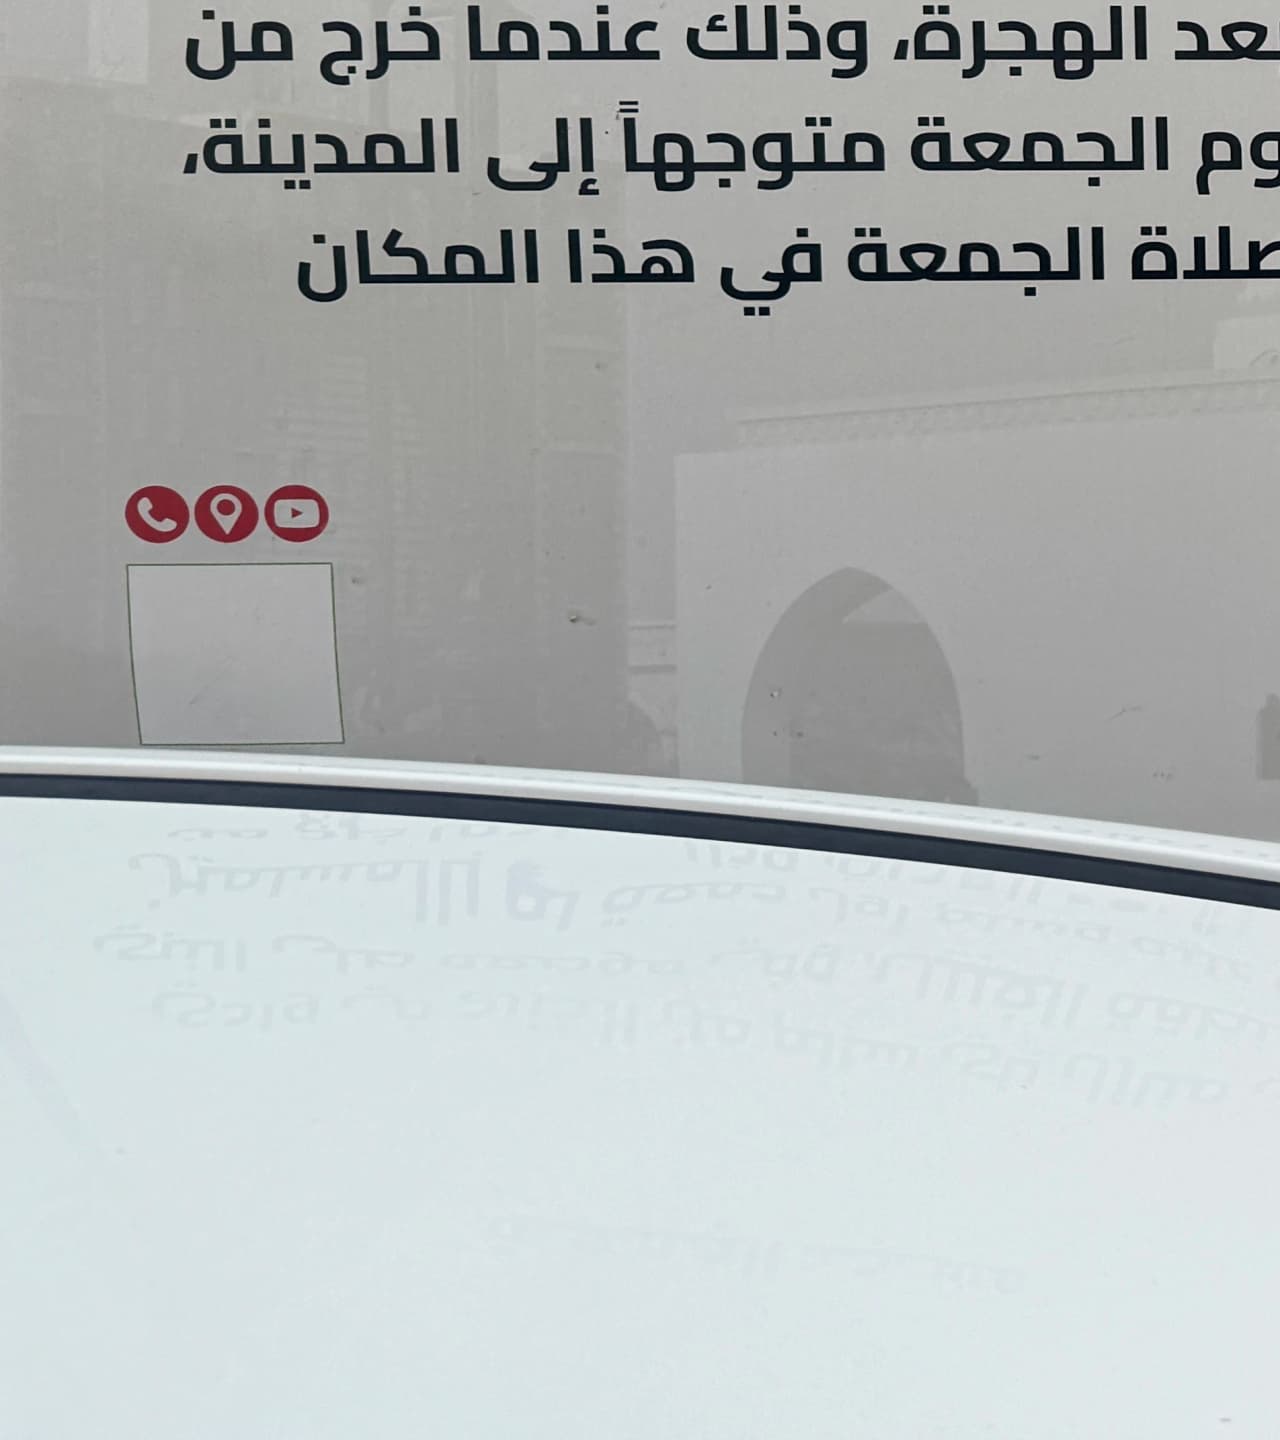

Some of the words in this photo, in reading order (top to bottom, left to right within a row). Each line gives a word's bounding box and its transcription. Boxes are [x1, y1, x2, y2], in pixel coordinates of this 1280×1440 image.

[185, 9, 294, 81] من
[319, 5, 441, 86] خرج
[467, 4, 661, 61] عندما
[686, 4, 868, 79] وذلك
[893, 4, 1148, 81] الهجرة،
[183, 117, 460, 190] المدينة،
[486, 117, 600, 196] إلى
[618, 100, 886, 192] متوجهاً
[910, 116, 1169, 187] الجمعة
[297, 228, 540, 303] المكان
[567, 228, 695, 284] هذا
[720, 227, 823, 317] في
[847, 226, 1105, 297] الجمعة
